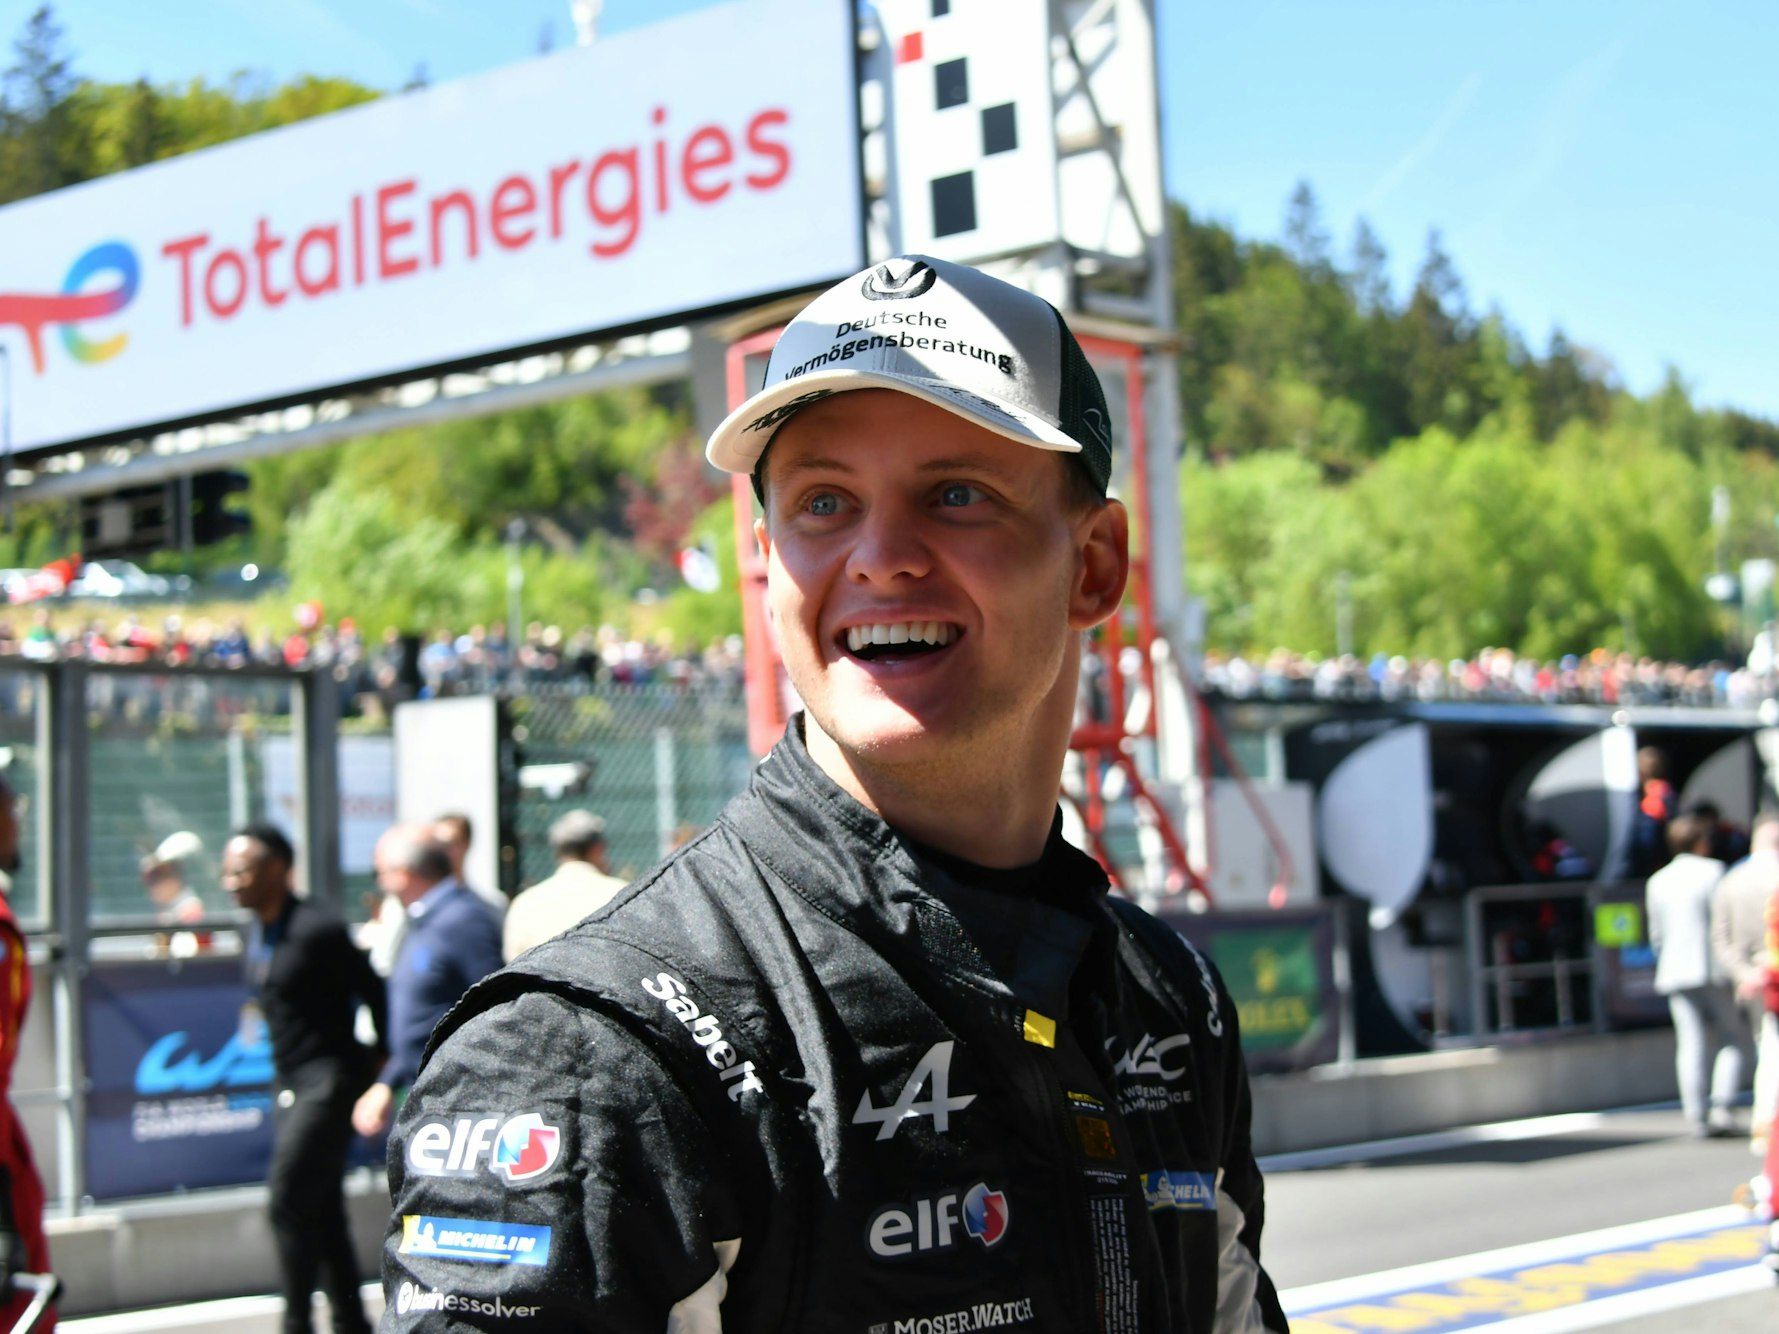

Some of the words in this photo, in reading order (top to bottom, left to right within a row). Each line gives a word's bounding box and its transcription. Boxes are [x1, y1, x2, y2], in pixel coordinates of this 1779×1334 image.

[161, 106, 792, 327] TotalEnergies
[835, 311, 947, 338] Deutsche
[785, 331, 1013, 380] Vermögensberatung
[641, 972, 764, 1102] Sabelt
[410, 1119, 498, 1170] elf
[437, 1230, 536, 1253] MICHELIN
[869, 1195, 960, 1257] elf
